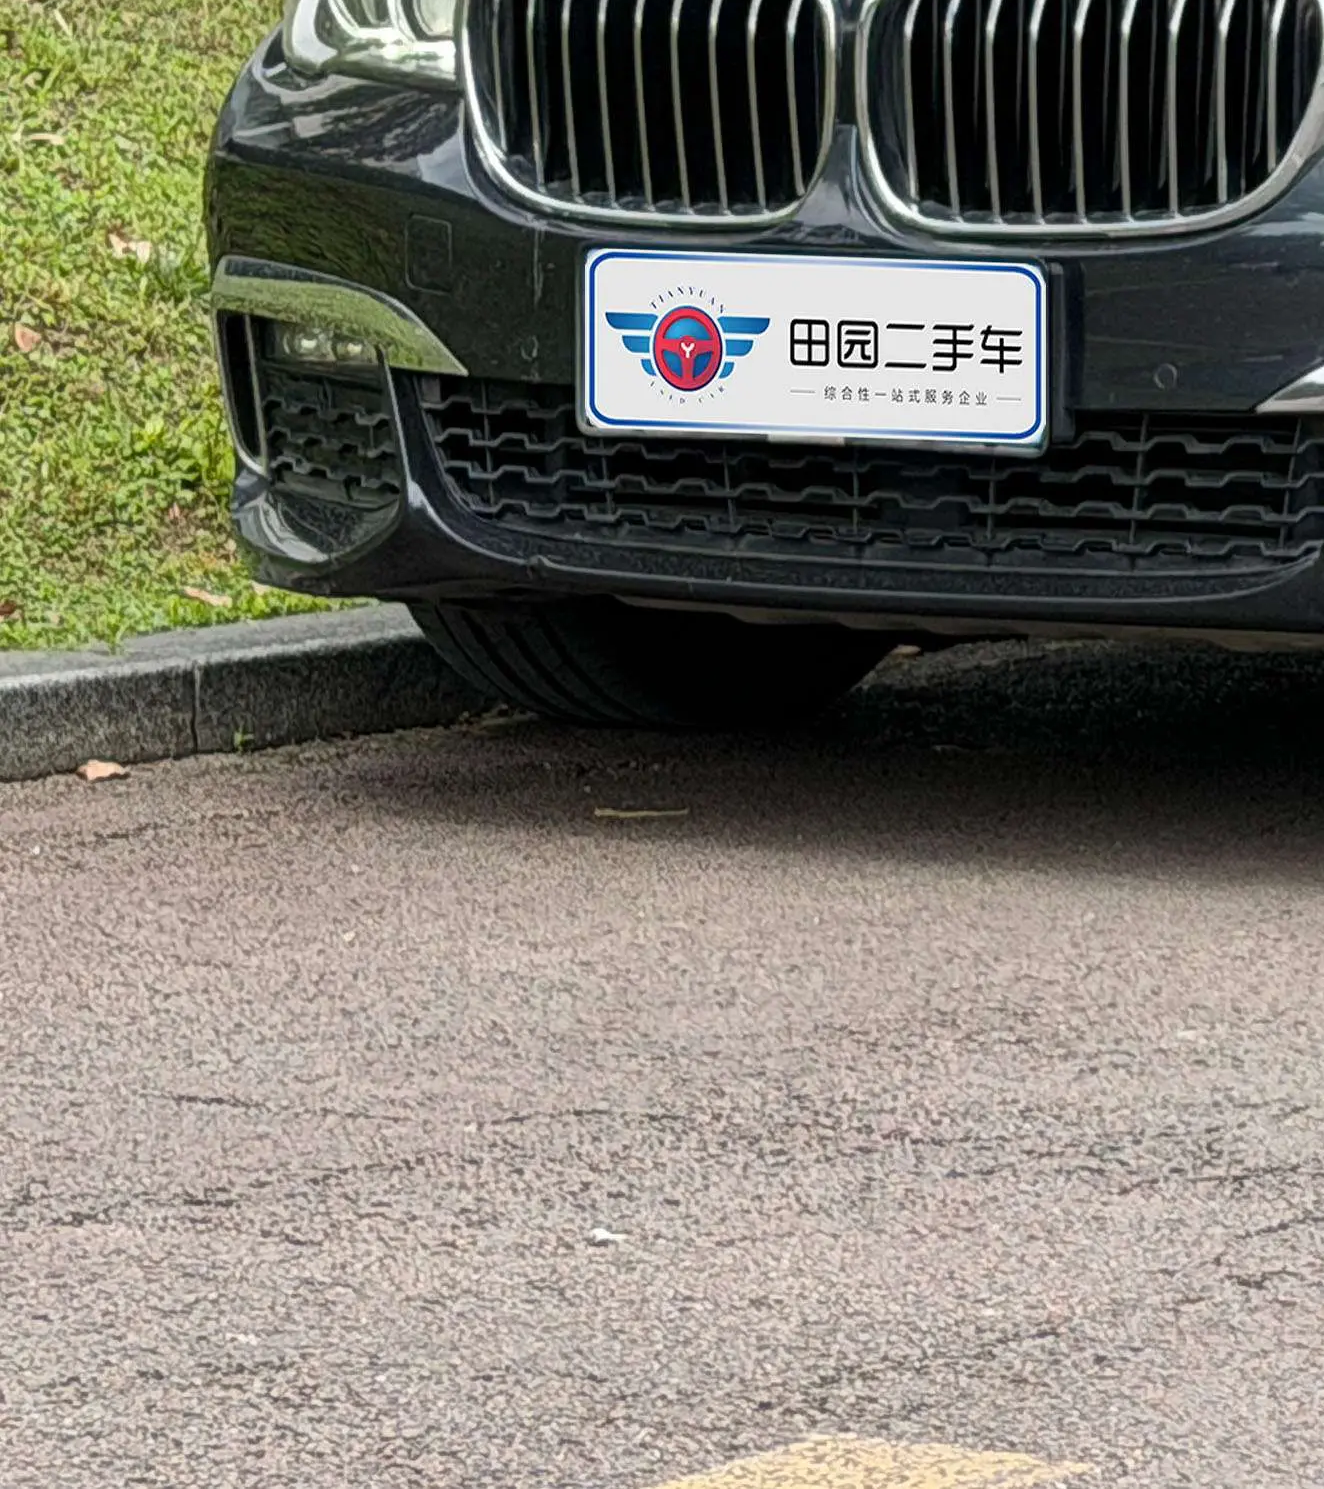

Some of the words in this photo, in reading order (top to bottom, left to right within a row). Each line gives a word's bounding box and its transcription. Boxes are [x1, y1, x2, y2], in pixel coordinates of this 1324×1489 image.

[790, 318, 1023, 374] 田园二手车
[823, 385, 988, 406] 综合性一站式服务企业
